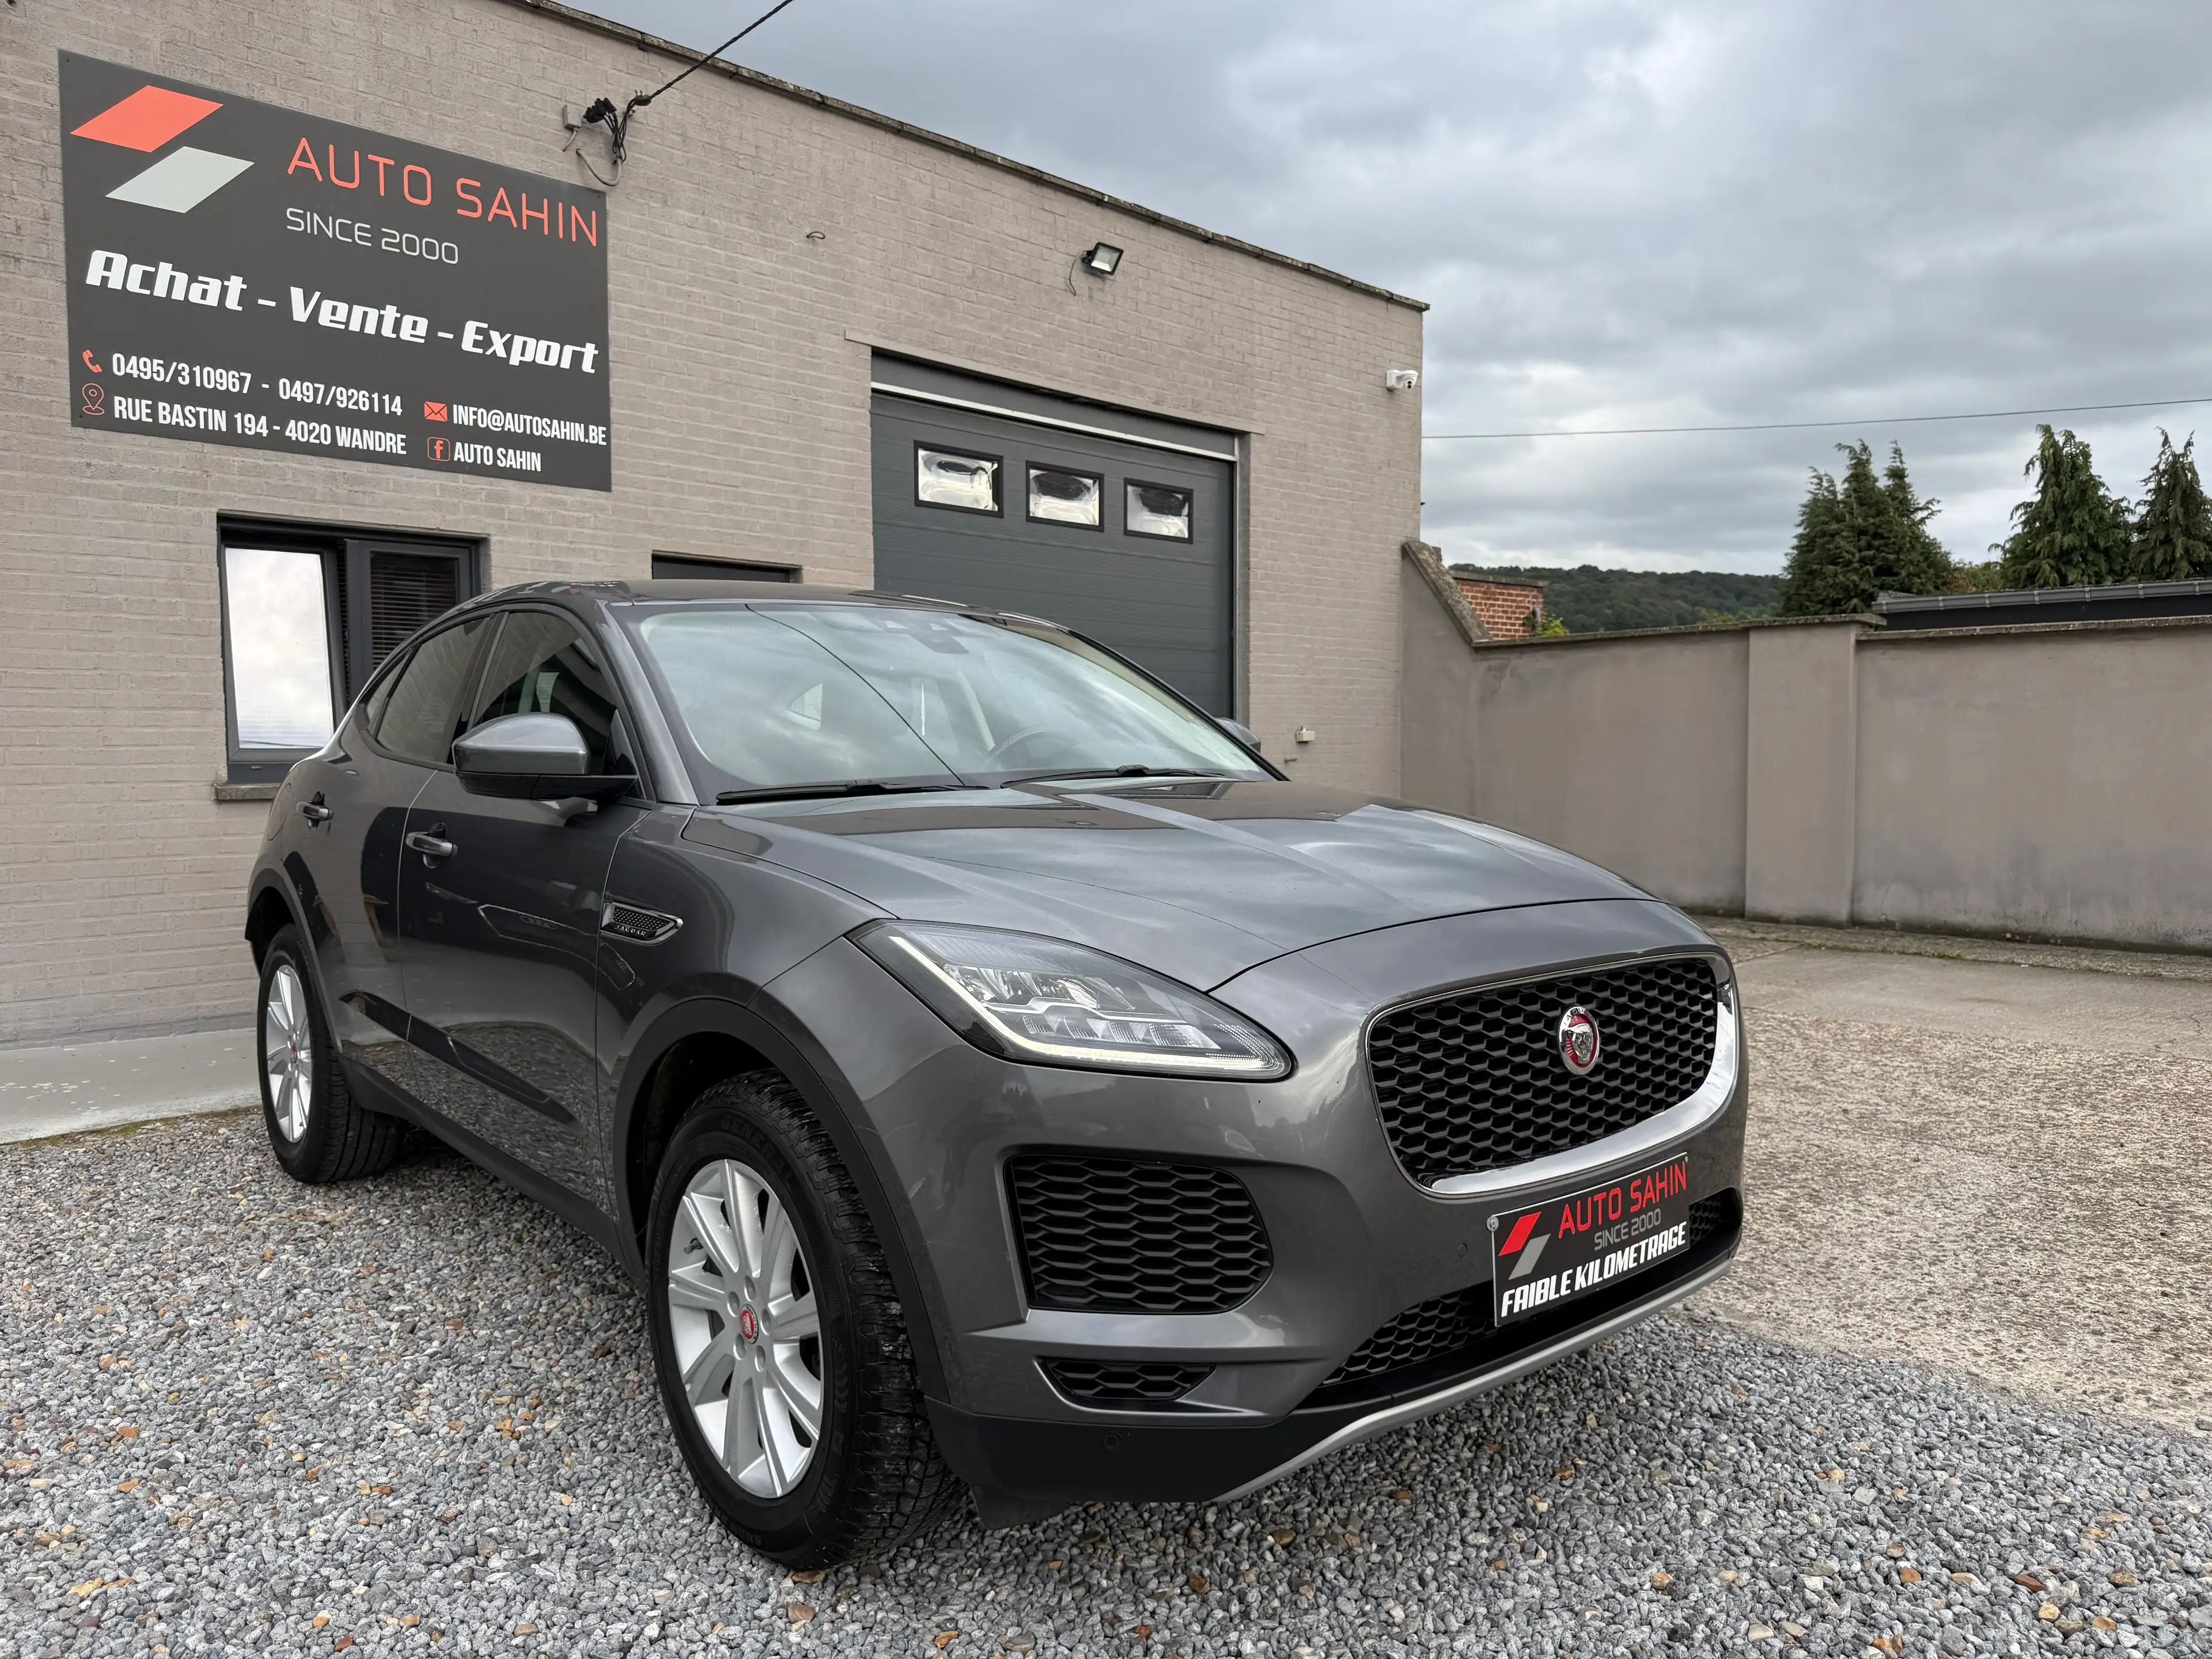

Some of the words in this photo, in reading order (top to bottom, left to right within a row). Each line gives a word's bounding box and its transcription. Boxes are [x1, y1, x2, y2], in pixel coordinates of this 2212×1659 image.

[287, 137, 432, 206] AUTO
[456, 177, 597, 247] SAHIN
[286, 207, 372, 247] SINCE
[381, 228, 459, 265] 2000
[85, 249, 248, 312] Achat
[290, 286, 429, 344] Vente
[461, 320, 599, 374] Export
[112, 353, 252, 394] 0495/310967
[278, 378, 403, 416] 0497/926114
[113, 395, 153, 423] RUE
[158, 402, 227, 432] BASTIN
[234, 412, 269, 437] 194
[285, 419, 332, 445] 4020
[335, 425, 407, 455] WANDRE
[452, 404, 607, 446] INFO@AUTOSAHIN.BE
[453, 441, 493, 466] AUTO
[497, 447, 541, 472] SAHIN
[614, 925, 646, 937] JAGUAR
[720, 1114, 794, 1191] GENERAL
[1558, 1187, 1622, 1239] AUTO
[1630, 1160, 1687, 1213] SAHIN
[1594, 1222, 1629, 1251] SINCE
[1631, 1207, 1661, 1236] 2000
[1501, 1269, 1573, 1318] FAIBLE
[1574, 1221, 1687, 1291] KILOMETRAGE
